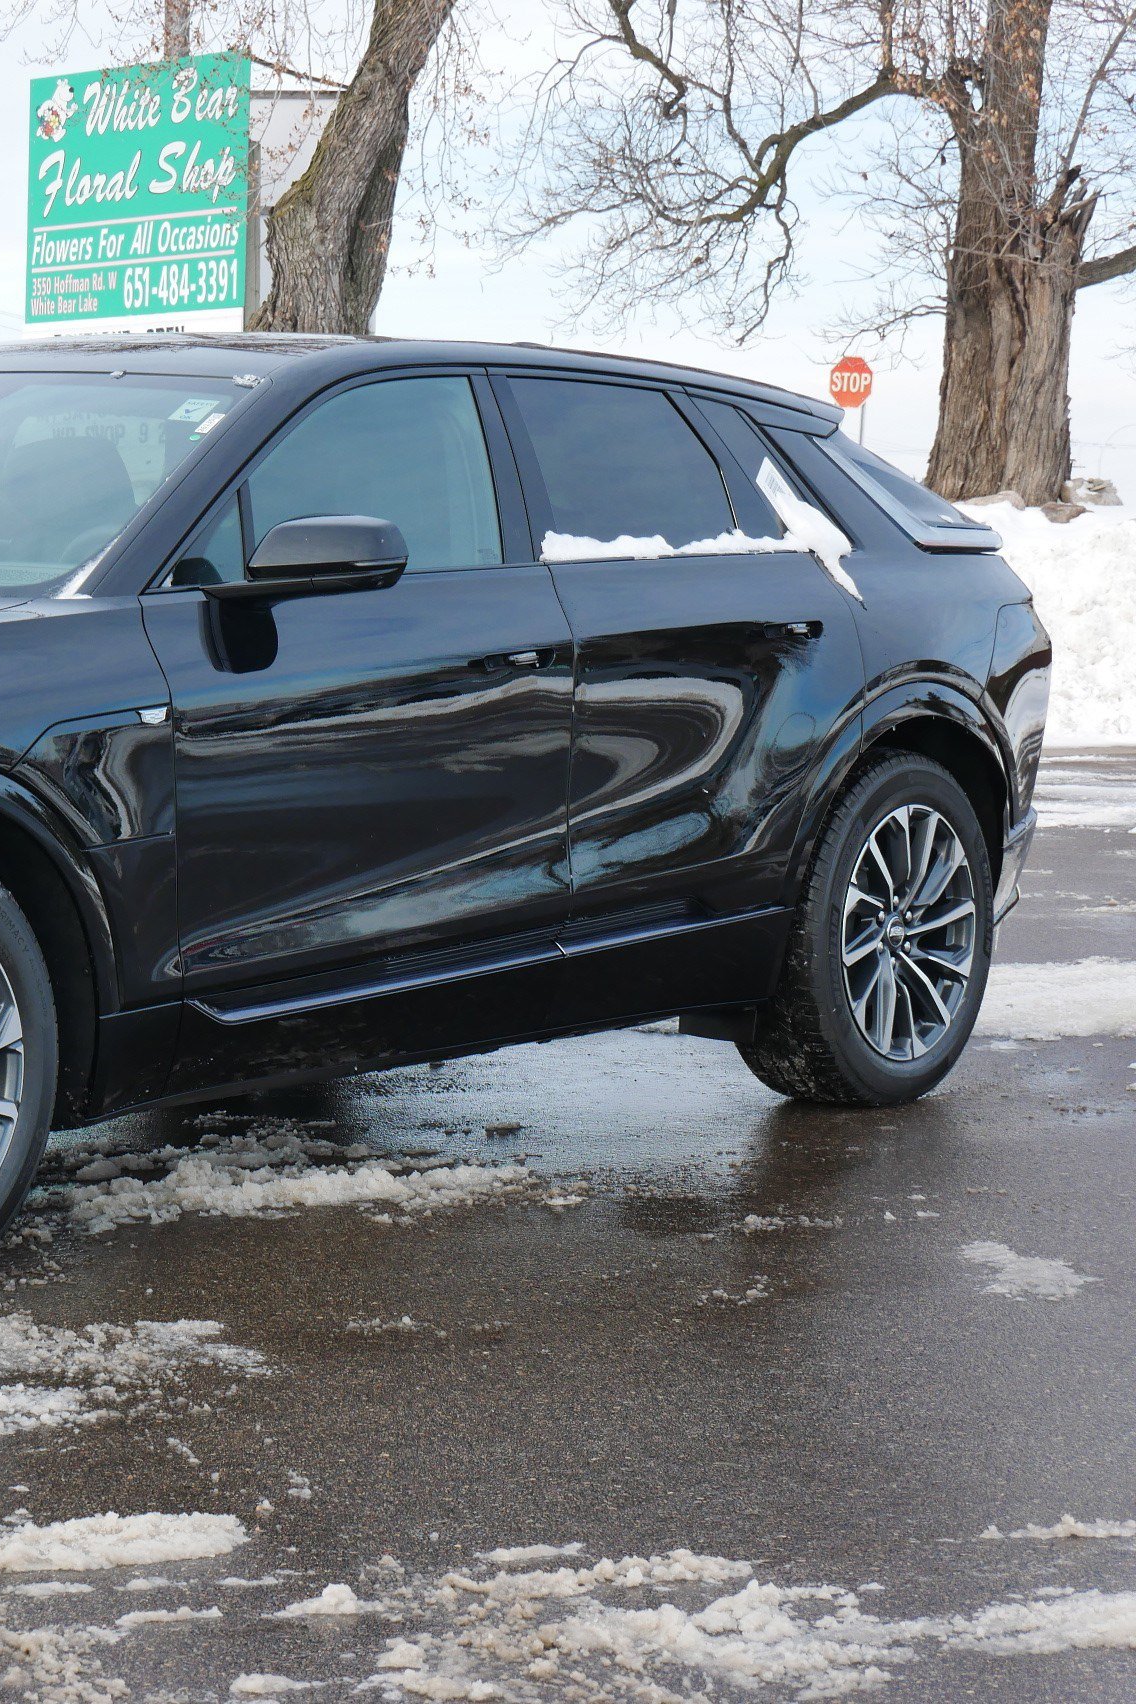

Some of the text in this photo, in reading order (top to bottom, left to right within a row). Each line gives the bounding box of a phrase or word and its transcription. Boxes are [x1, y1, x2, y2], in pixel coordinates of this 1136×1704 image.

[83, 67, 239, 137] White Bear
[38, 140, 237, 218] Floral Shop
[31, 216, 239, 265] Flowers For All Occasions
[30, 294, 98, 316] White Bear Lake
[32, 271, 118, 296] 3550 Hoffman Rd. W
[123, 259, 238, 309] 651-484-3391
[831, 372, 871, 393] STOP
